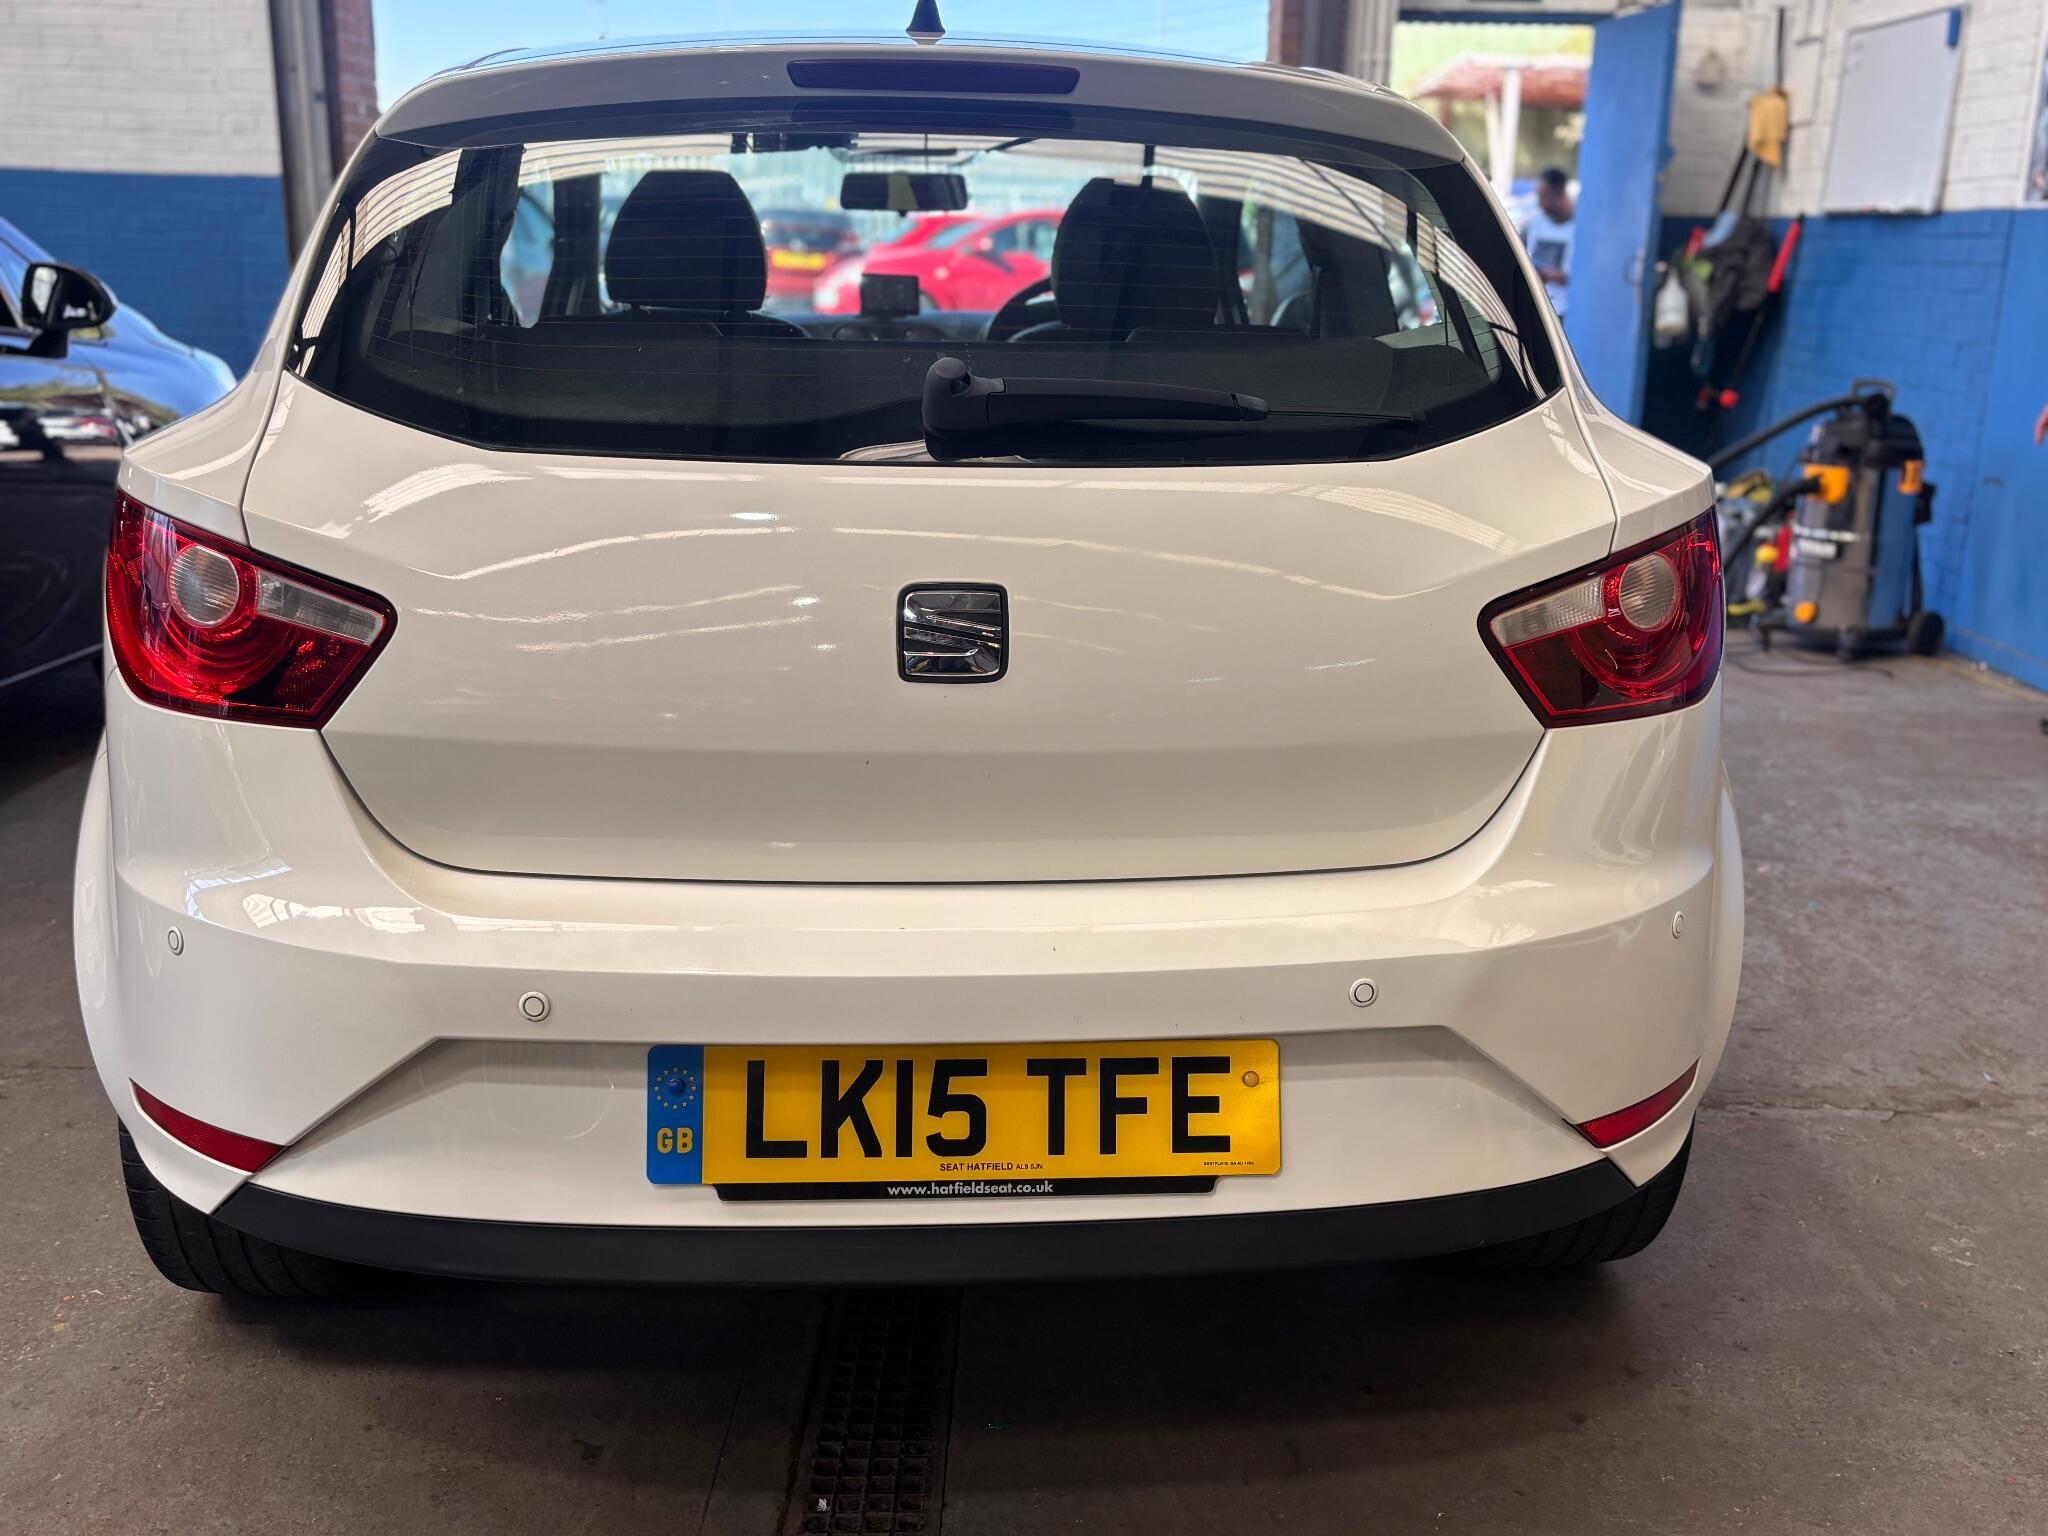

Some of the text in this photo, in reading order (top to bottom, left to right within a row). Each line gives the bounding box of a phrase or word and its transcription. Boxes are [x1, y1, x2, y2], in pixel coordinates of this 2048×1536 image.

[745, 1056, 1231, 1159] LK15 TFE
[656, 1127, 693, 1154] GB
[940, 1163, 965, 1171] SEAT
[967, 1162, 1014, 1171] HATFIELD
[886, 1181, 1054, 1195] www.hatfieldseat.co.uk
